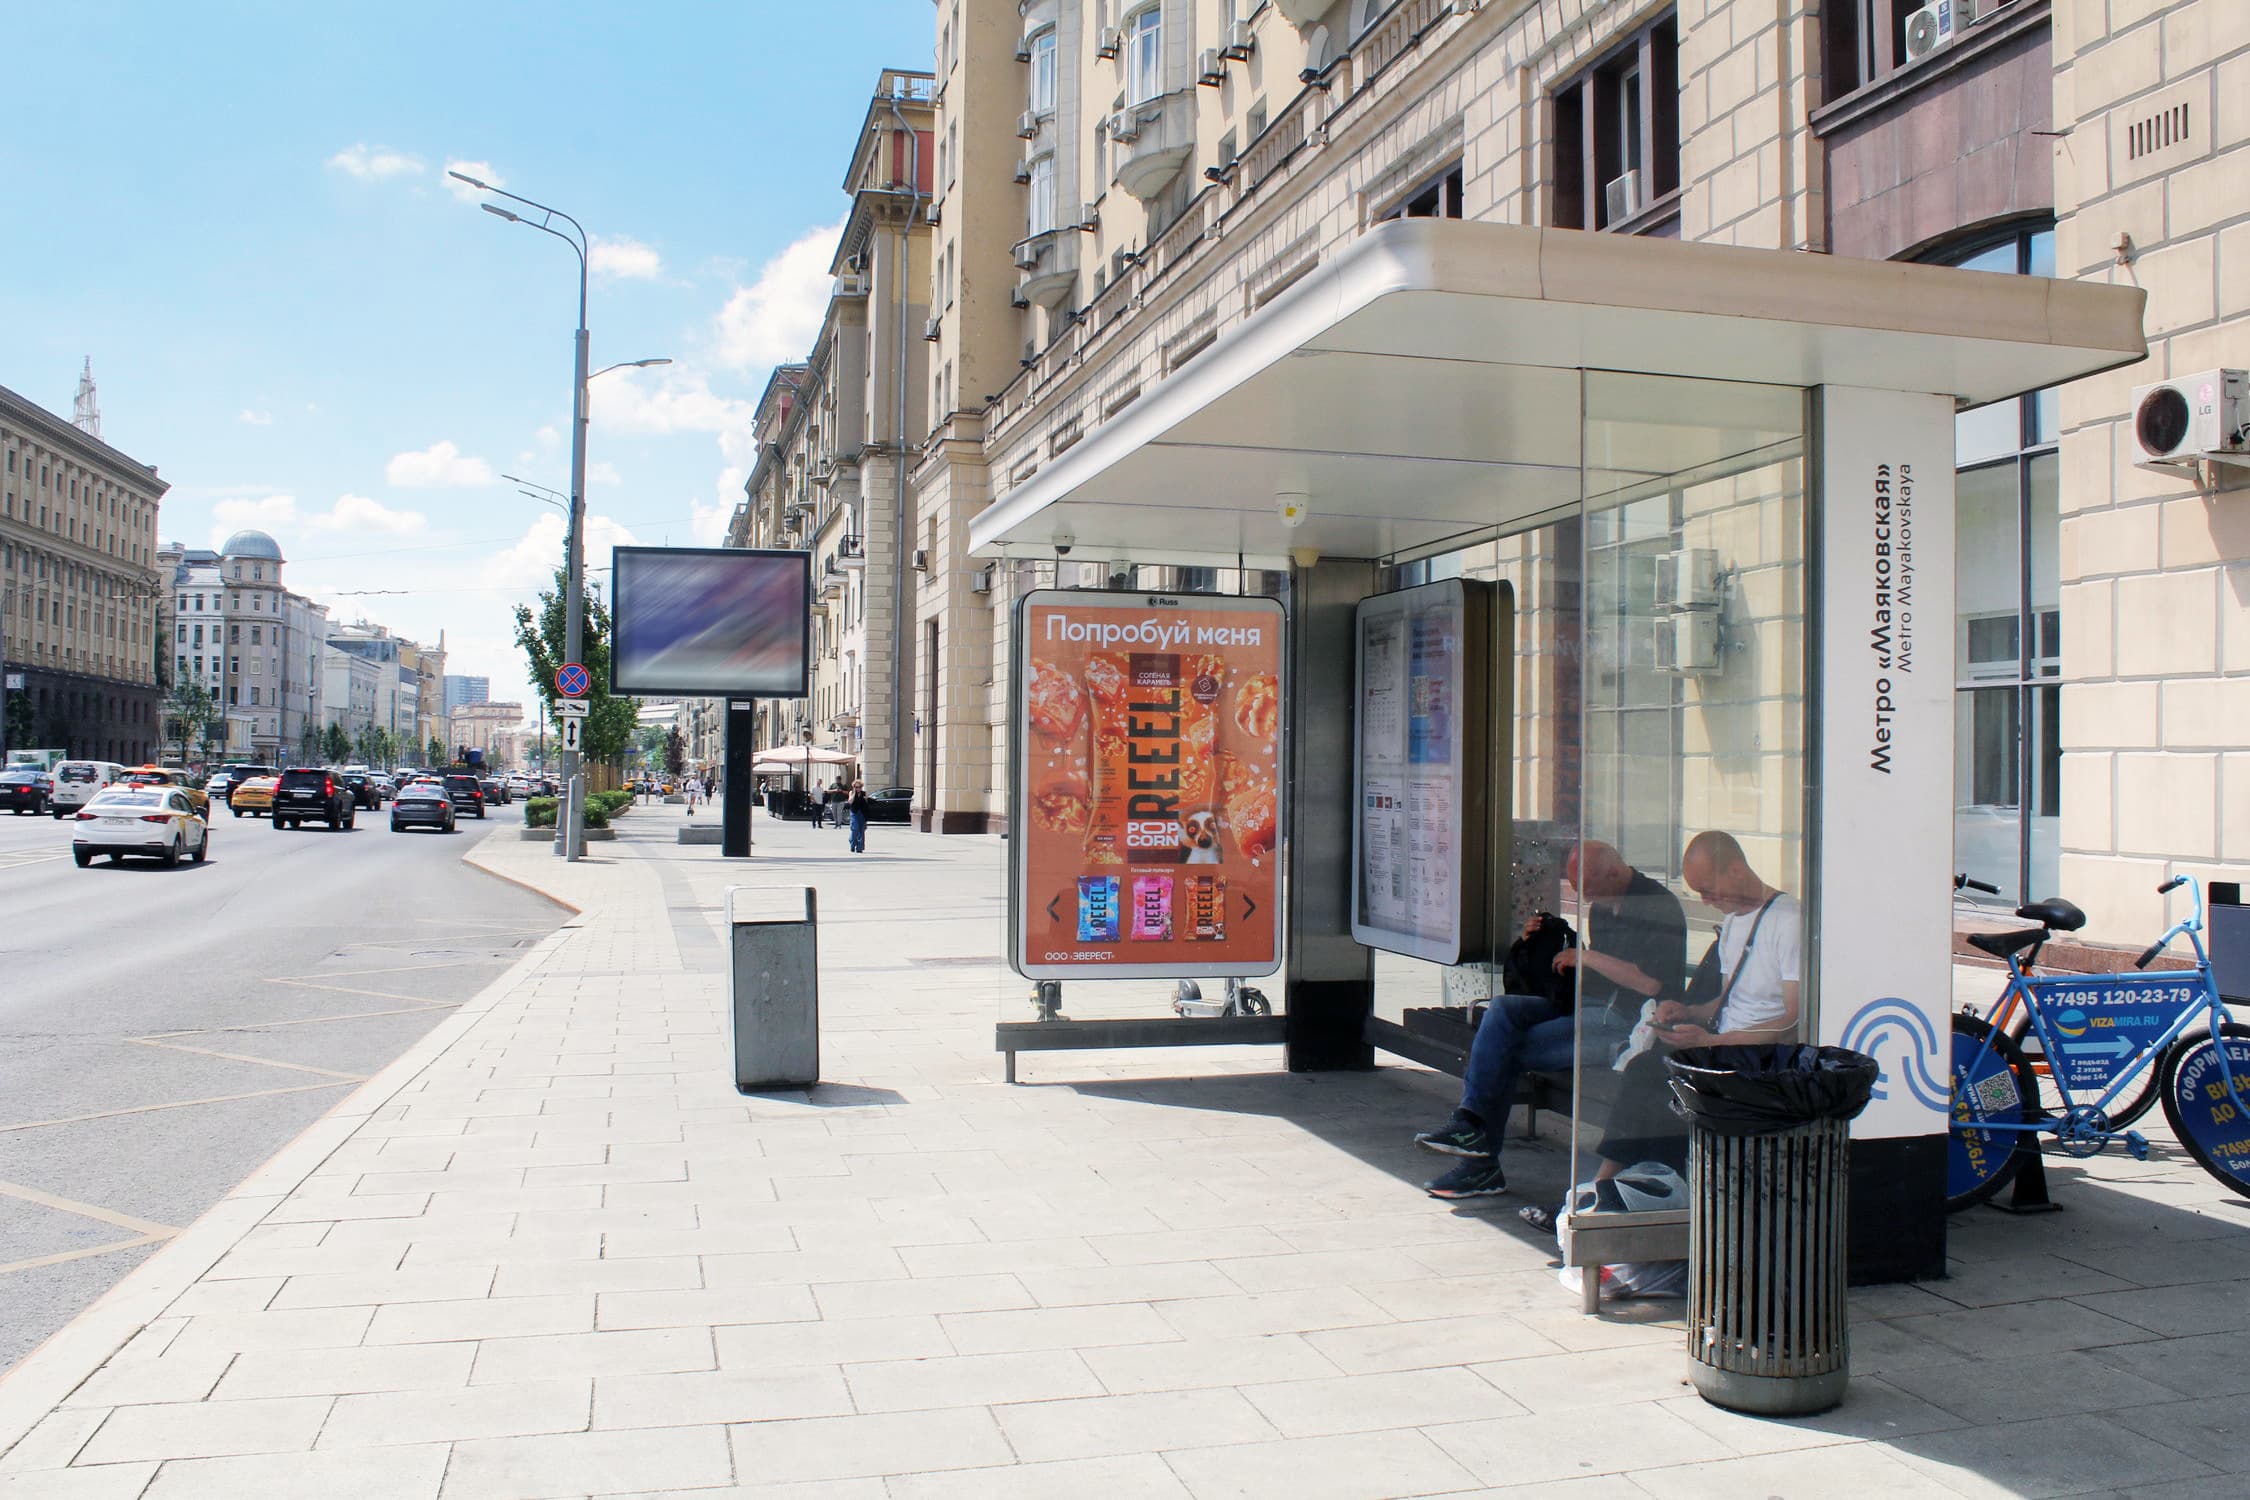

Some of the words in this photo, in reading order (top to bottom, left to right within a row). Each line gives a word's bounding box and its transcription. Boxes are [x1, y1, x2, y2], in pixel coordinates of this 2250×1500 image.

[2199, 405, 2212, 416] LG
[1895, 464, 1915, 606] Mayakovskaya
[1871, 463, 1892, 669] «Маяковская»
[1159, 598, 1179, 607] Russ
[1046, 614, 1190, 650] Попробуй
[1196, 626, 1261, 646] меня
[1896, 612, 1913, 673] Metro
[1871, 677, 1896, 774] Метро
[1128, 690, 1180, 820] REEEL
[1126, 834, 1179, 847] CORN
[1127, 822, 1180, 834] POP
[1090, 887, 1107, 927] REEEL
[1144, 887, 1161, 927] REEEL
[1196, 887, 1213, 927] REEEL
[1045, 952, 1068, 961] ООО
[2043, 991, 2098, 1006] +7495
[2103, 988, 2191, 1005] 120-23-79
[2089, 1015, 2160, 1028] VIZAMIRA.RU
[2210, 1103, 2236, 1125] ДО
